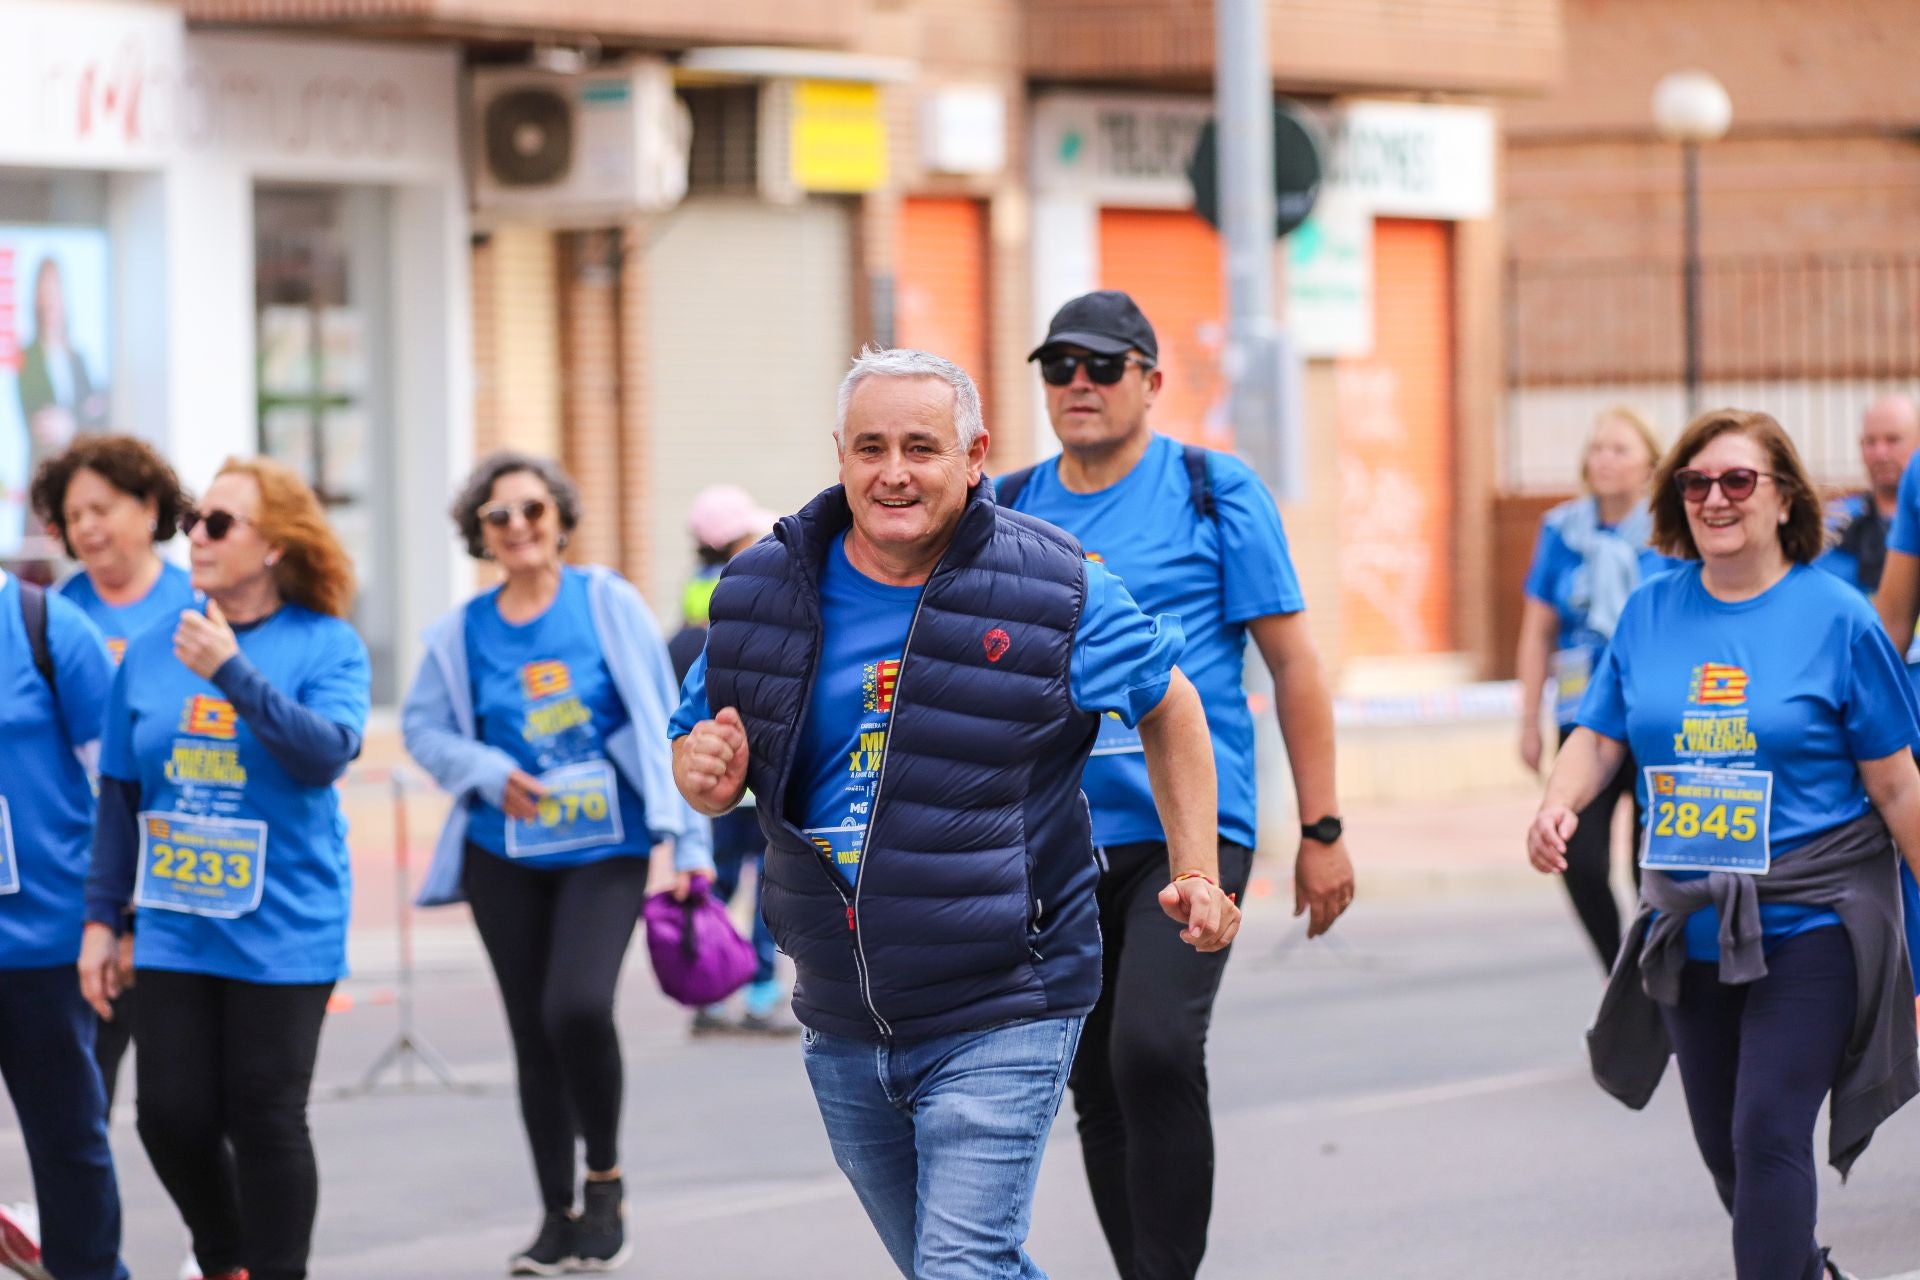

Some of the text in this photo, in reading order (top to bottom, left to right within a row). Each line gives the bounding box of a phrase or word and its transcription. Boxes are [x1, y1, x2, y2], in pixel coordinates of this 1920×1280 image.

[1688, 732, 1758, 752] VALENCIA
[849, 751, 863, 772] X
[1655, 802, 1757, 841] 2845
[152, 844, 251, 888] 2233
[837, 848, 862, 865] MUÉ
